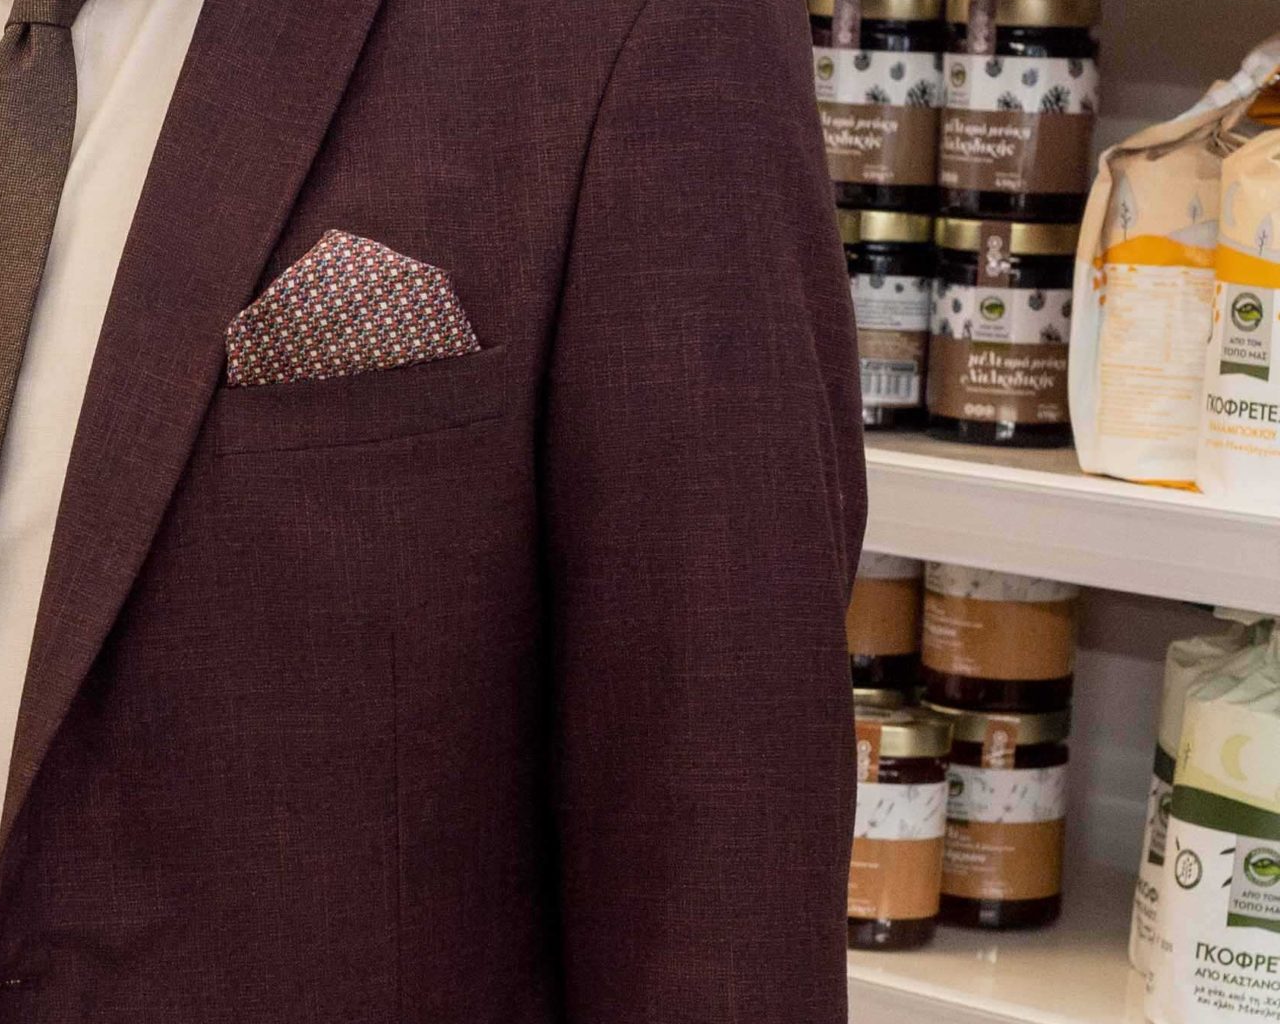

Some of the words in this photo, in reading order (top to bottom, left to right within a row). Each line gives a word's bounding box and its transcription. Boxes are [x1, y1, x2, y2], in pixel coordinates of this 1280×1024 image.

[1207, 393, 1280, 423] ΓΚΟΦΡΕΤΕ
[1234, 899, 1263, 912] ΤΟΠΟ
[1265, 905, 1280, 914] ΜΑ
[1242, 891, 1261, 899] ΑΠΟ
[1196, 942, 1280, 974] ΓΚΟΦΡΕ
[1195, 968, 1220, 981] ΑΠΟ
[1223, 973, 1280, 991] ΚΑΣΤΑΝΟ
